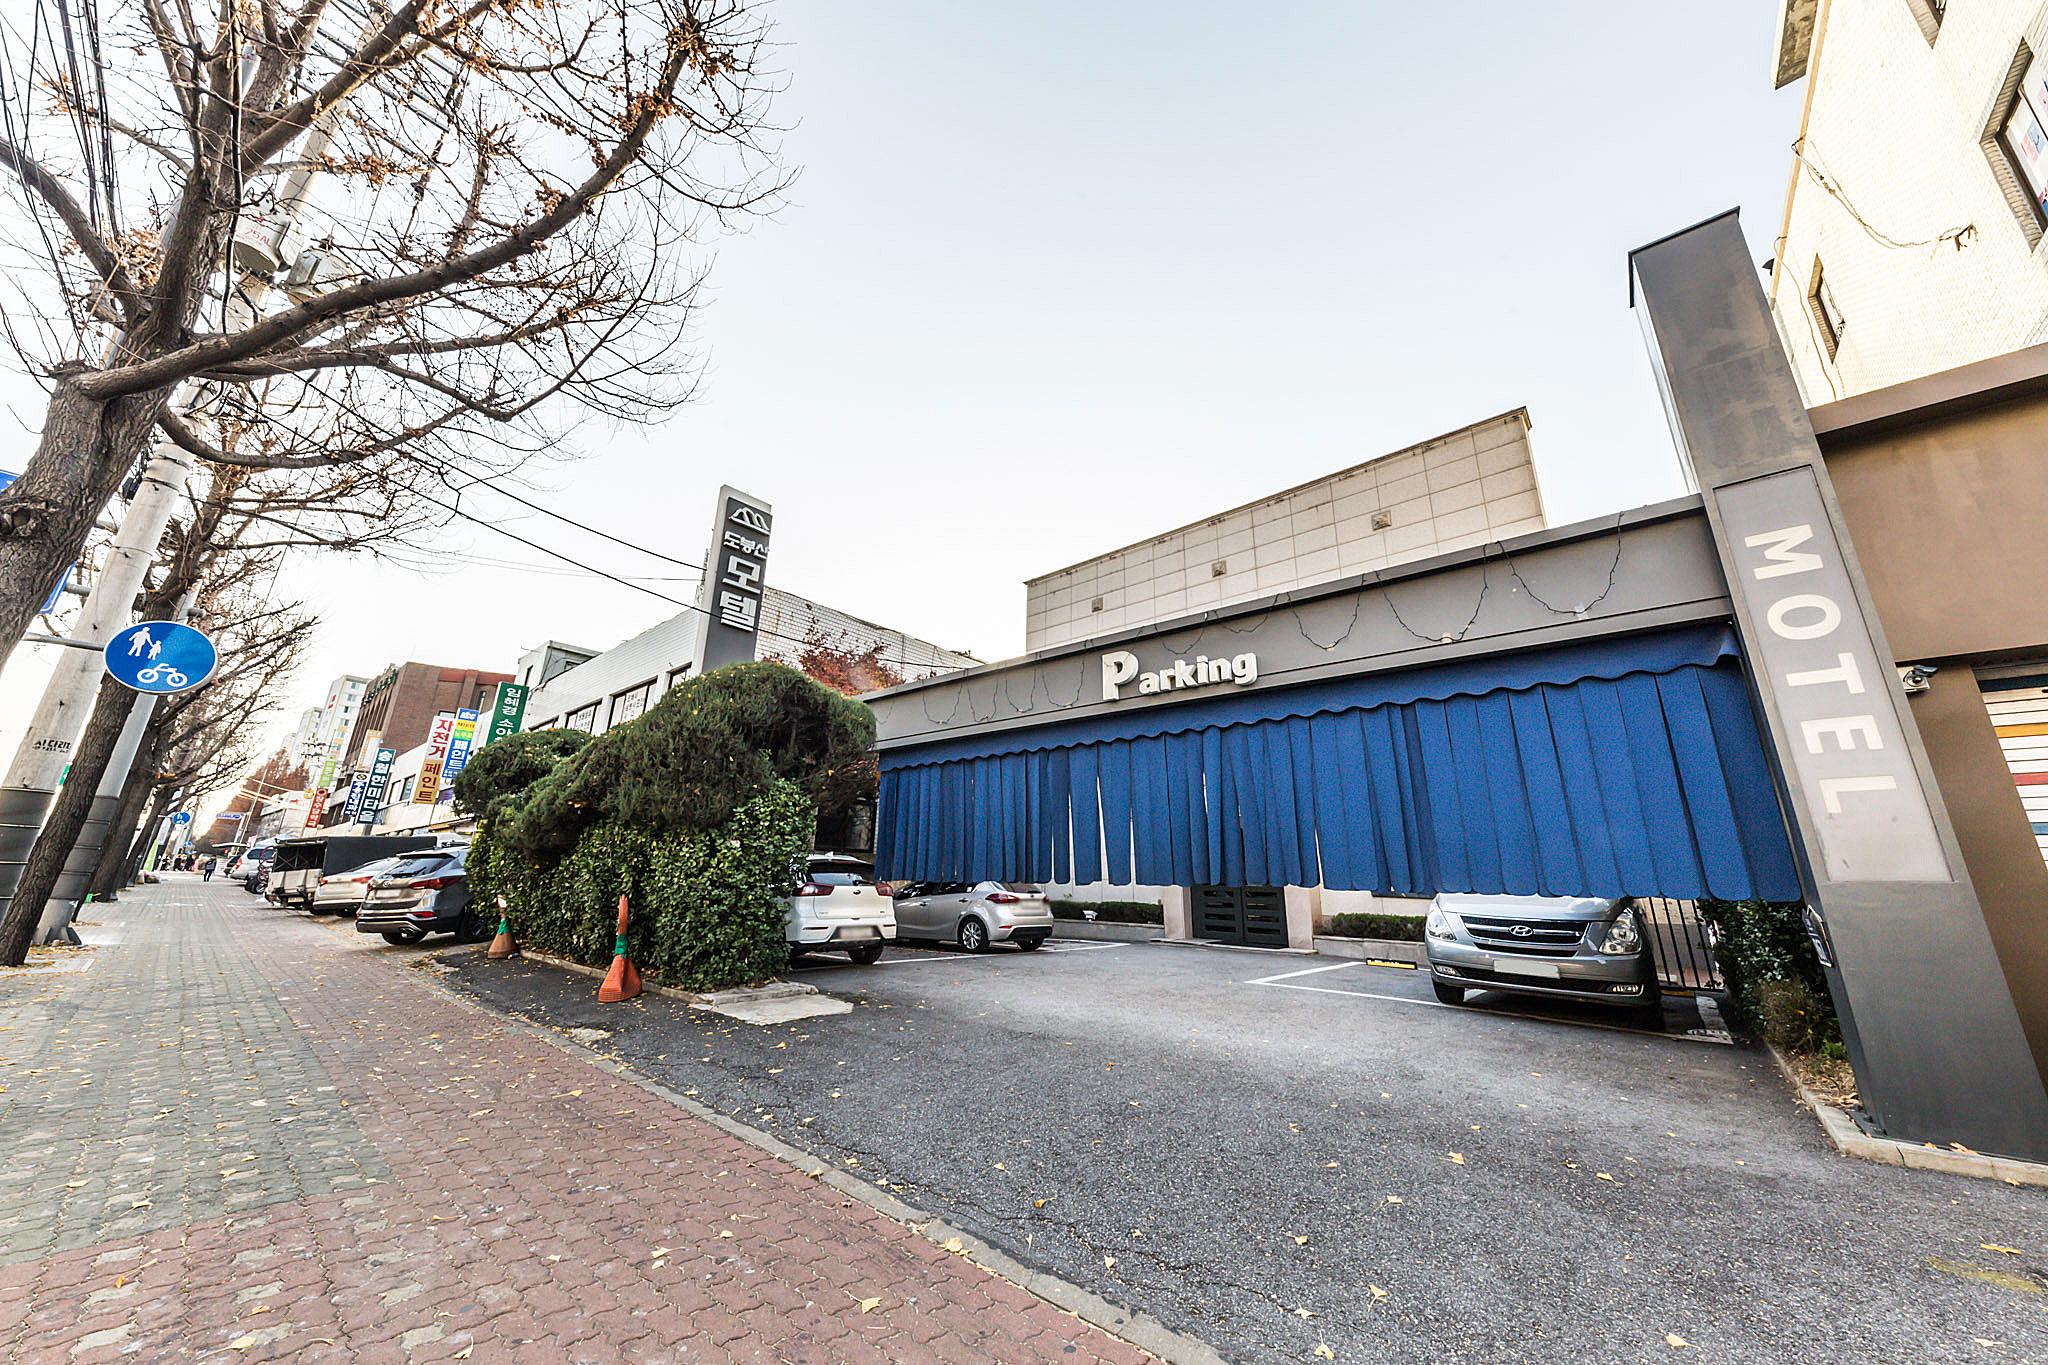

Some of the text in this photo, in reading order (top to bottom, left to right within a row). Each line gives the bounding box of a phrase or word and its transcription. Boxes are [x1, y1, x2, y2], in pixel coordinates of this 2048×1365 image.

[723, 530, 771, 560] 도봉산
[720, 555, 761, 632] 모텔
[1102, 651, 1258, 701] Parking
[1744, 524, 1897, 814] MOTEL
[429, 719, 453, 759] 자전거
[416, 763, 441, 802] 페인트
